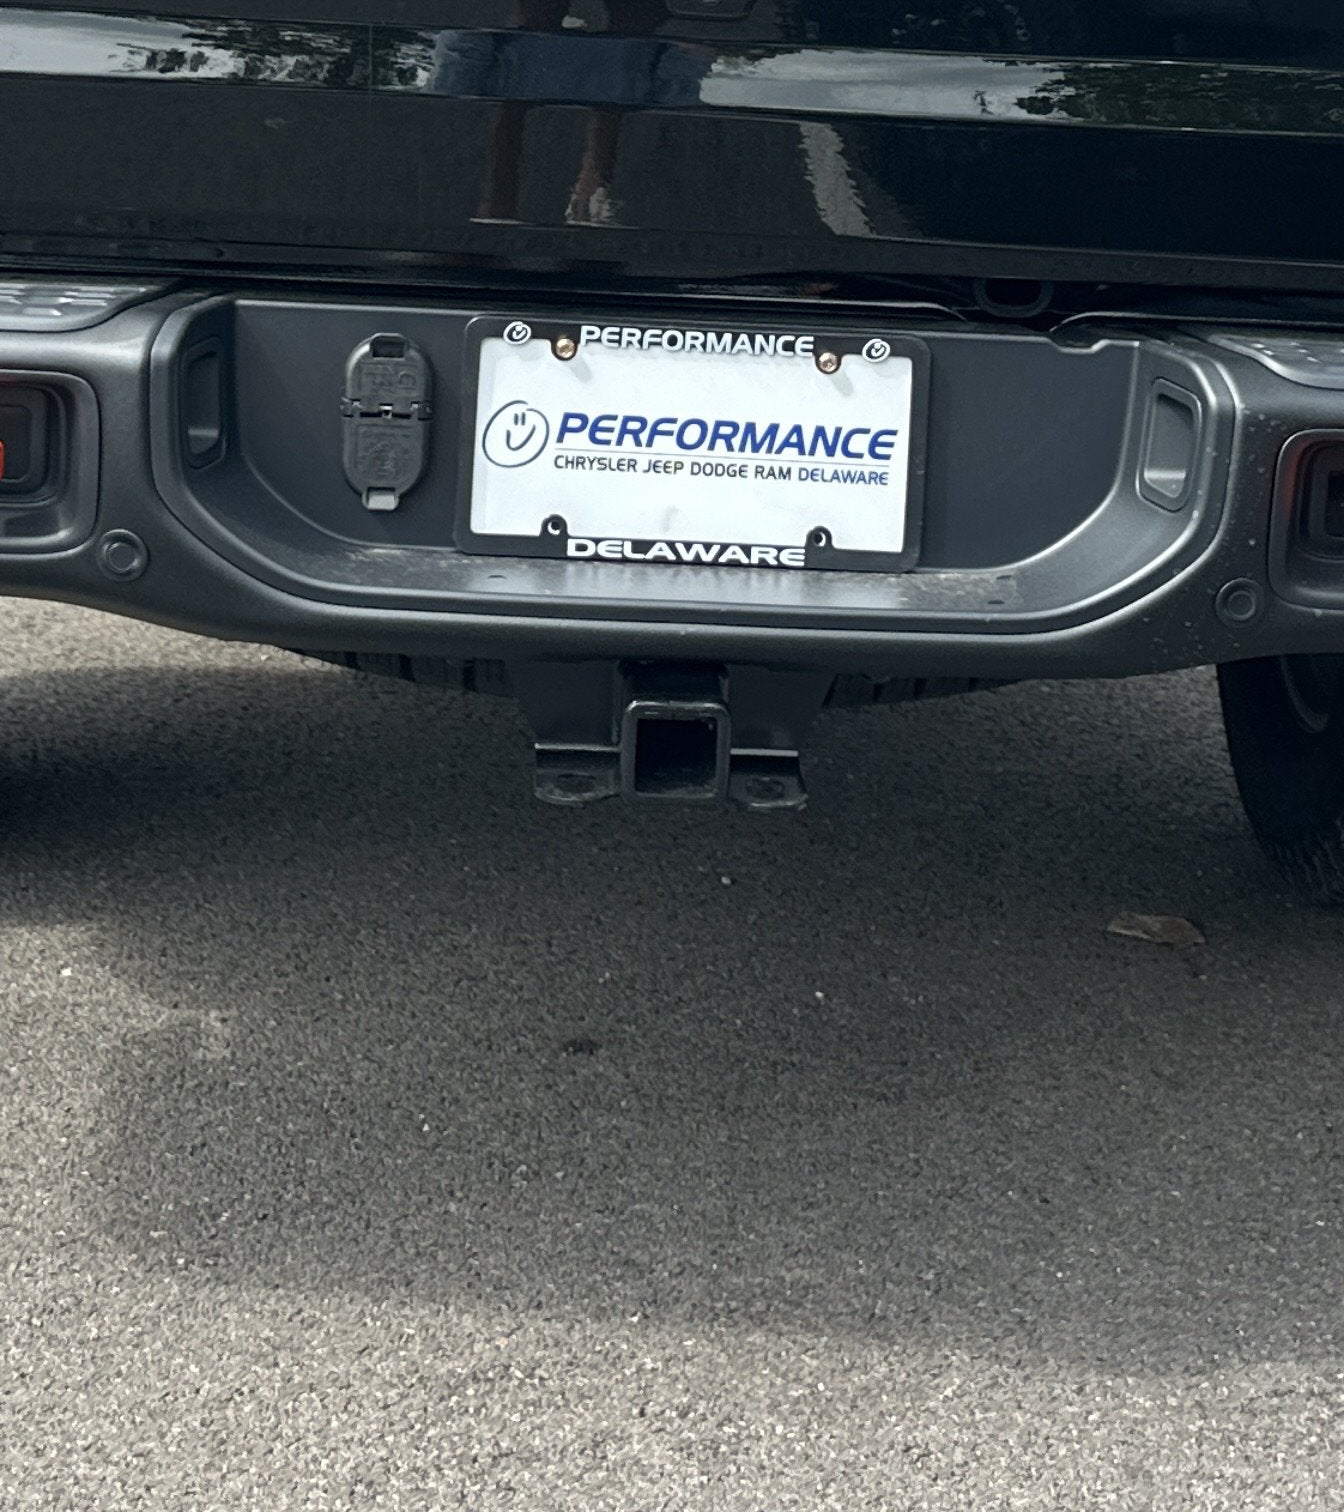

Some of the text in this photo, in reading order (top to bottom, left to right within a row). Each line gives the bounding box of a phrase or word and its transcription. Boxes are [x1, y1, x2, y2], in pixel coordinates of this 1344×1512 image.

[579, 325, 815, 356] PERFORMANCE
[556, 412, 899, 460] PERFORMANCE
[554, 455, 889, 486] CHRYSLER JEEP DODGE RAM DELAWARE
[566, 538, 806, 567] DELAWARE
